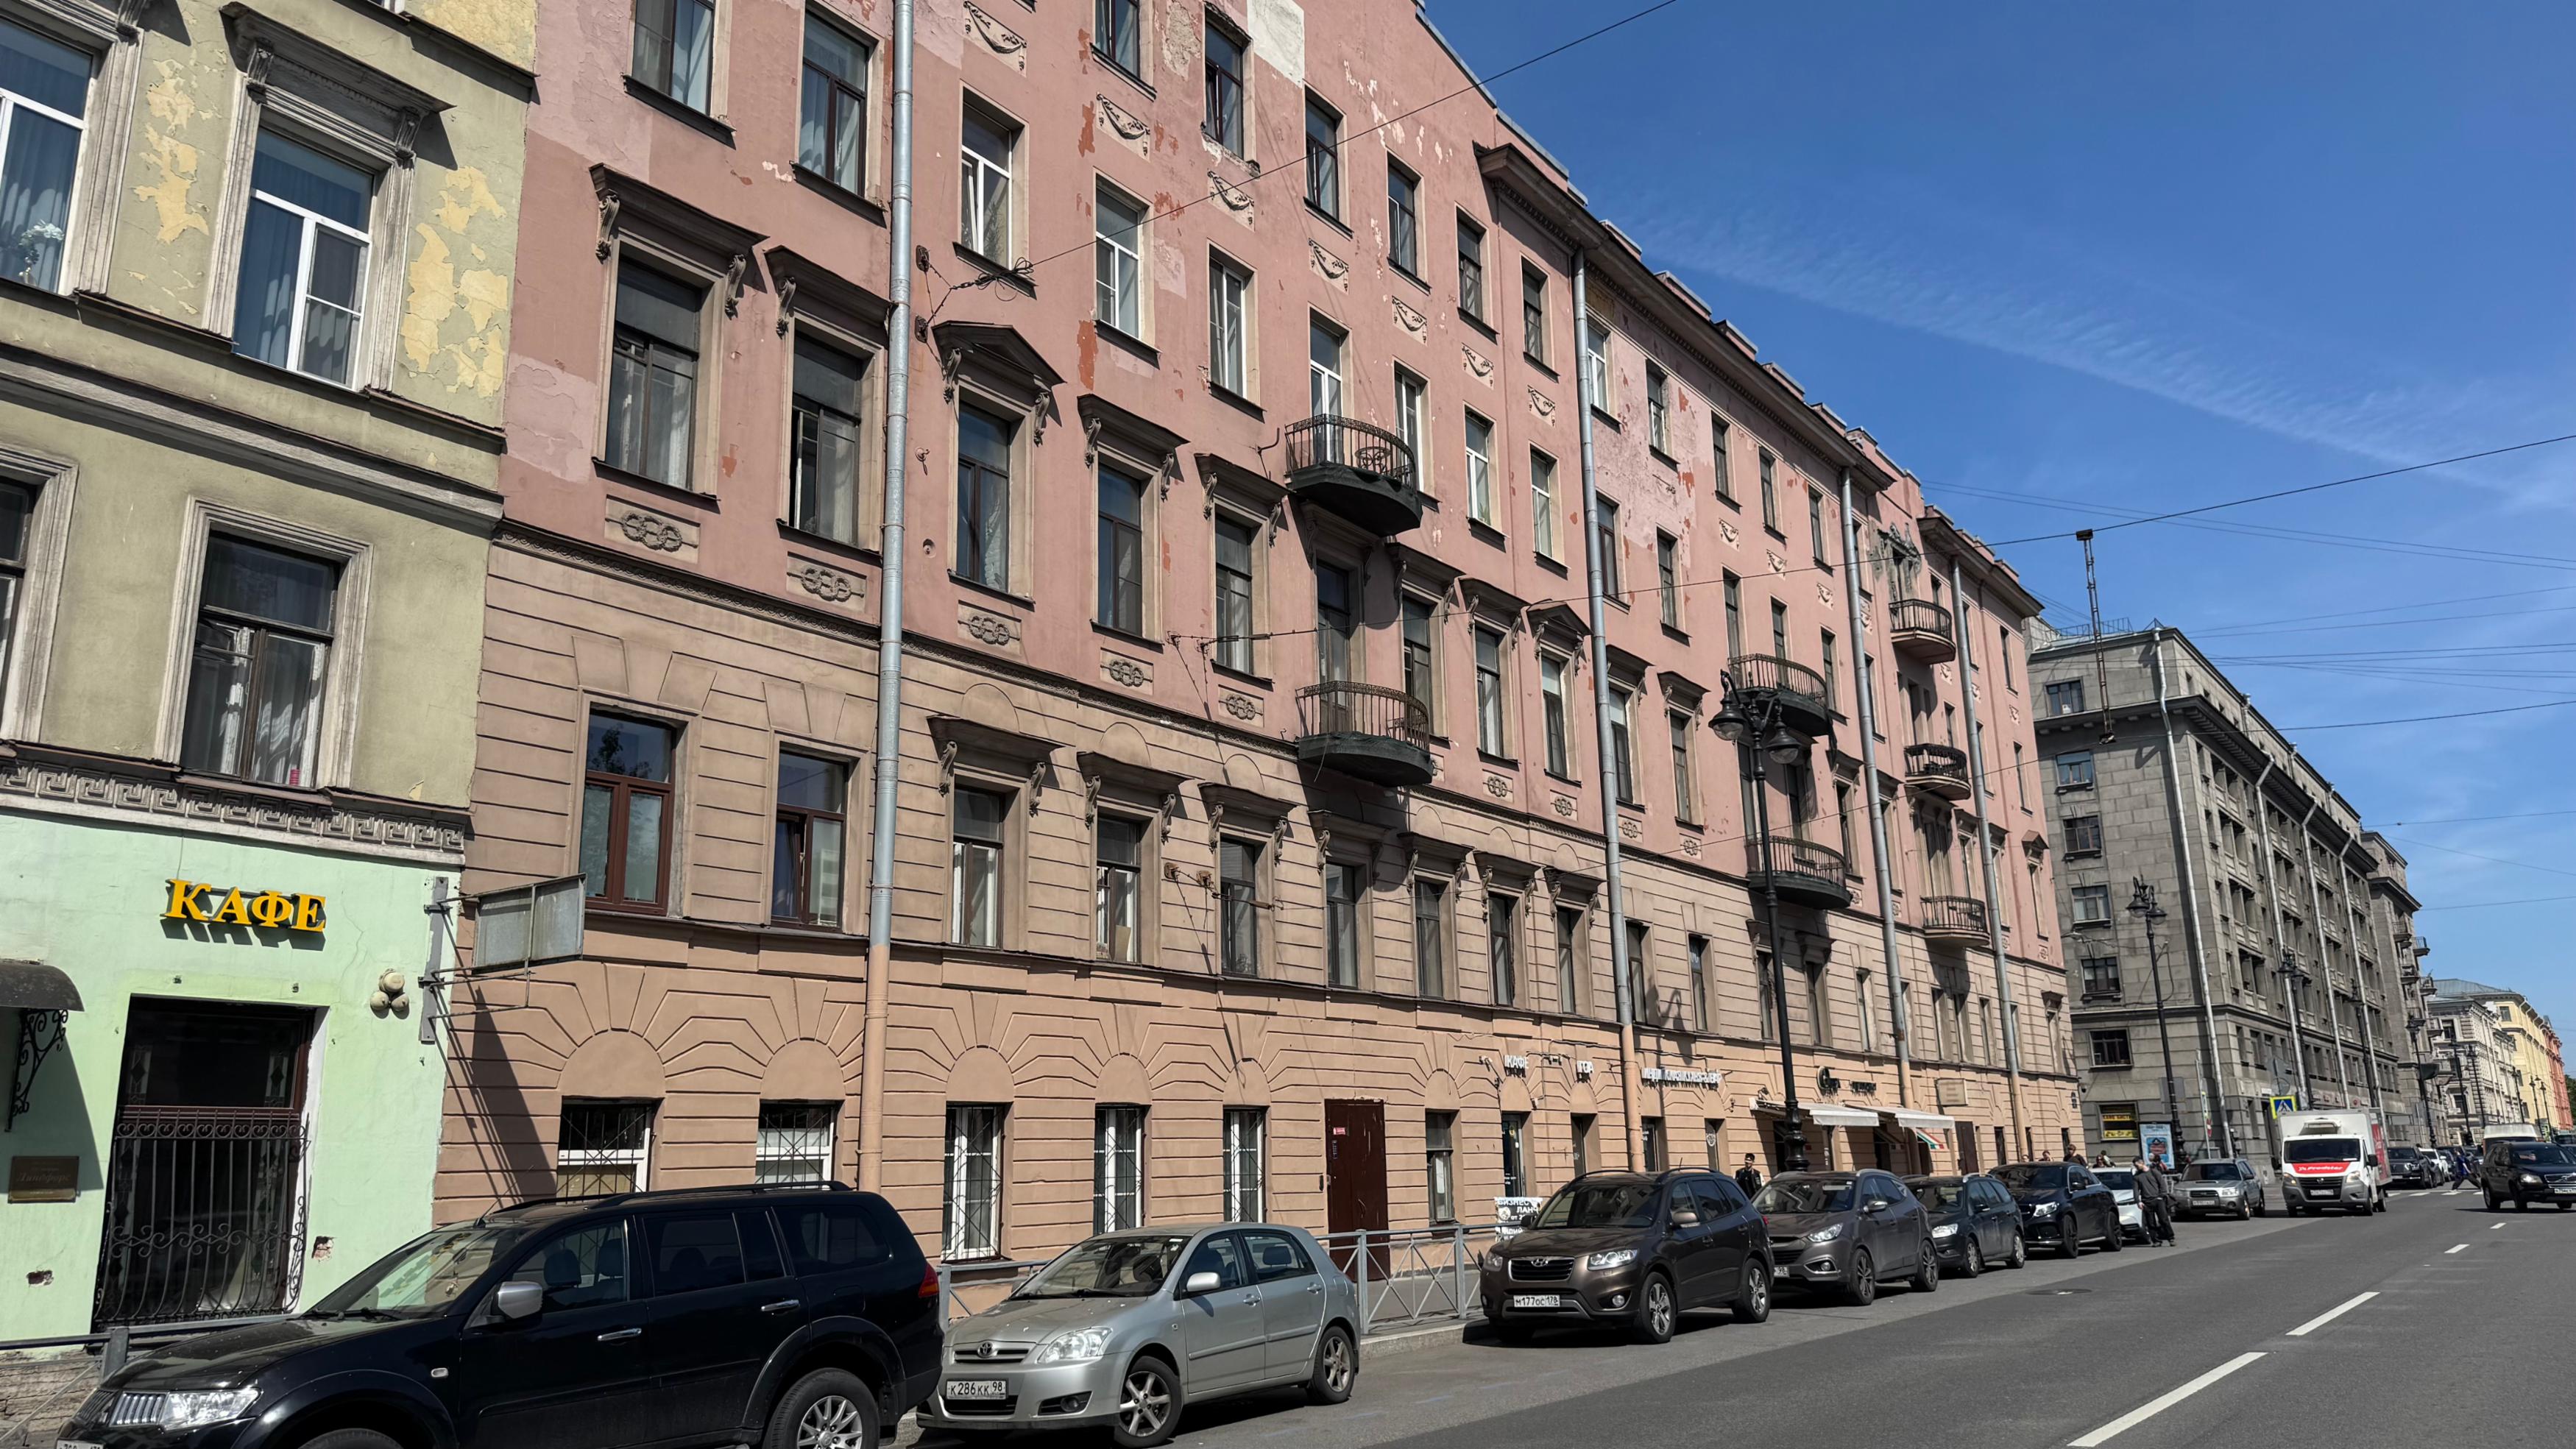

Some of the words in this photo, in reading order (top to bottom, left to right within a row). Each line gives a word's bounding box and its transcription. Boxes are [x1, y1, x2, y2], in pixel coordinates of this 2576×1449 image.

[161, 879, 326, 932] КАФЕ
[1504, 1055, 1529, 1069] КАФЕ
[1517, 1206, 1539, 1214] ЛАНЧ
